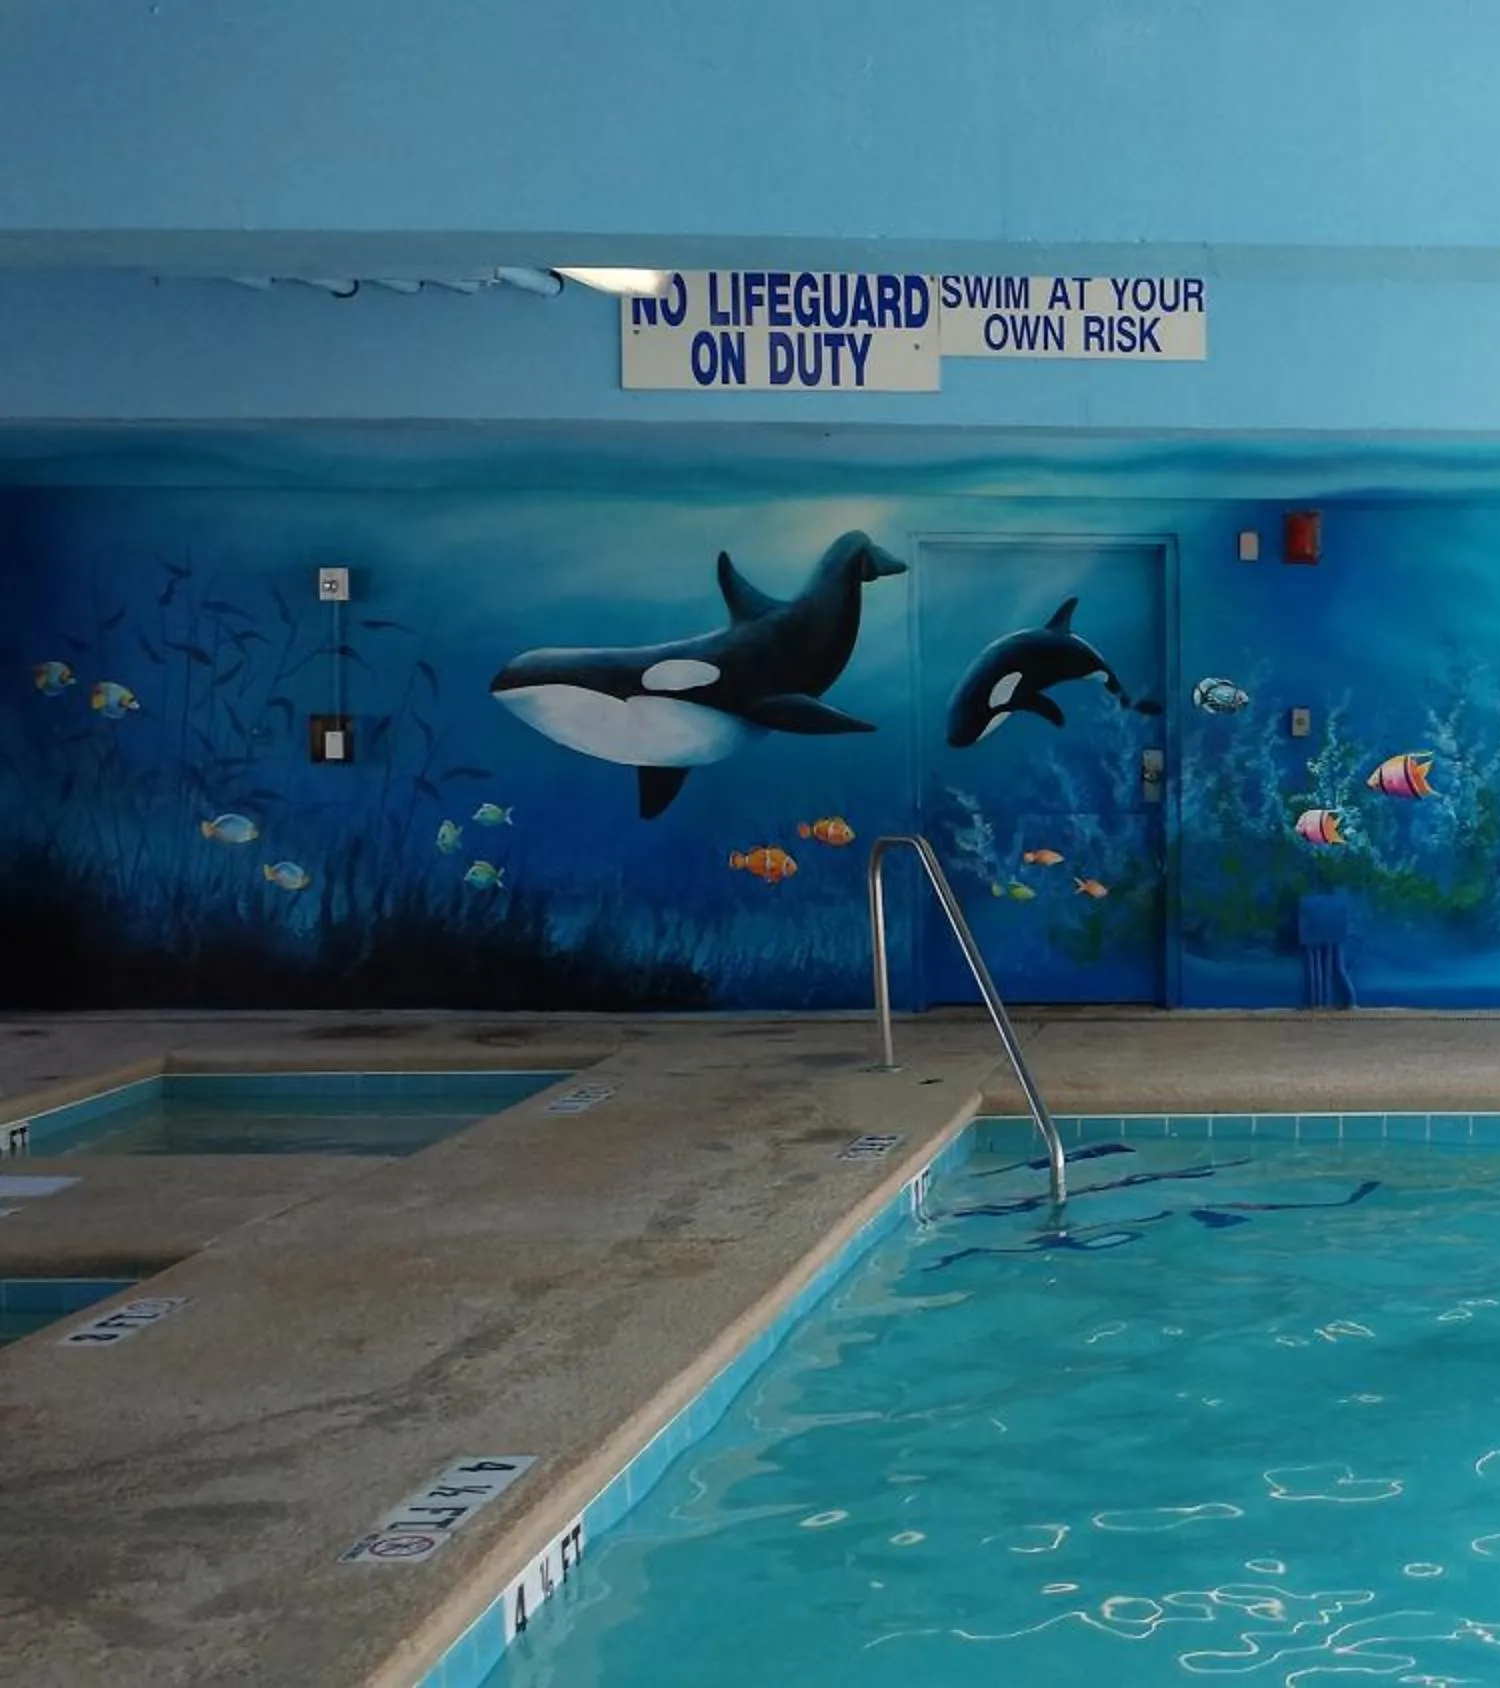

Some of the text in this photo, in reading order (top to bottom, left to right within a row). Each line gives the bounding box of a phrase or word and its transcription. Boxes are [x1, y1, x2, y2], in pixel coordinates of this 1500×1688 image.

[632, 271, 930, 329] NO LIFEGUARD
[941, 274, 1205, 313] SWIM AT YOUR
[984, 313, 1163, 353] OWN RISK
[691, 330, 873, 387] ON DUTY
[386, 1506, 469, 1531] FT
[514, 1583, 528, 1634] 4
[560, 1523, 582, 1584] FT
